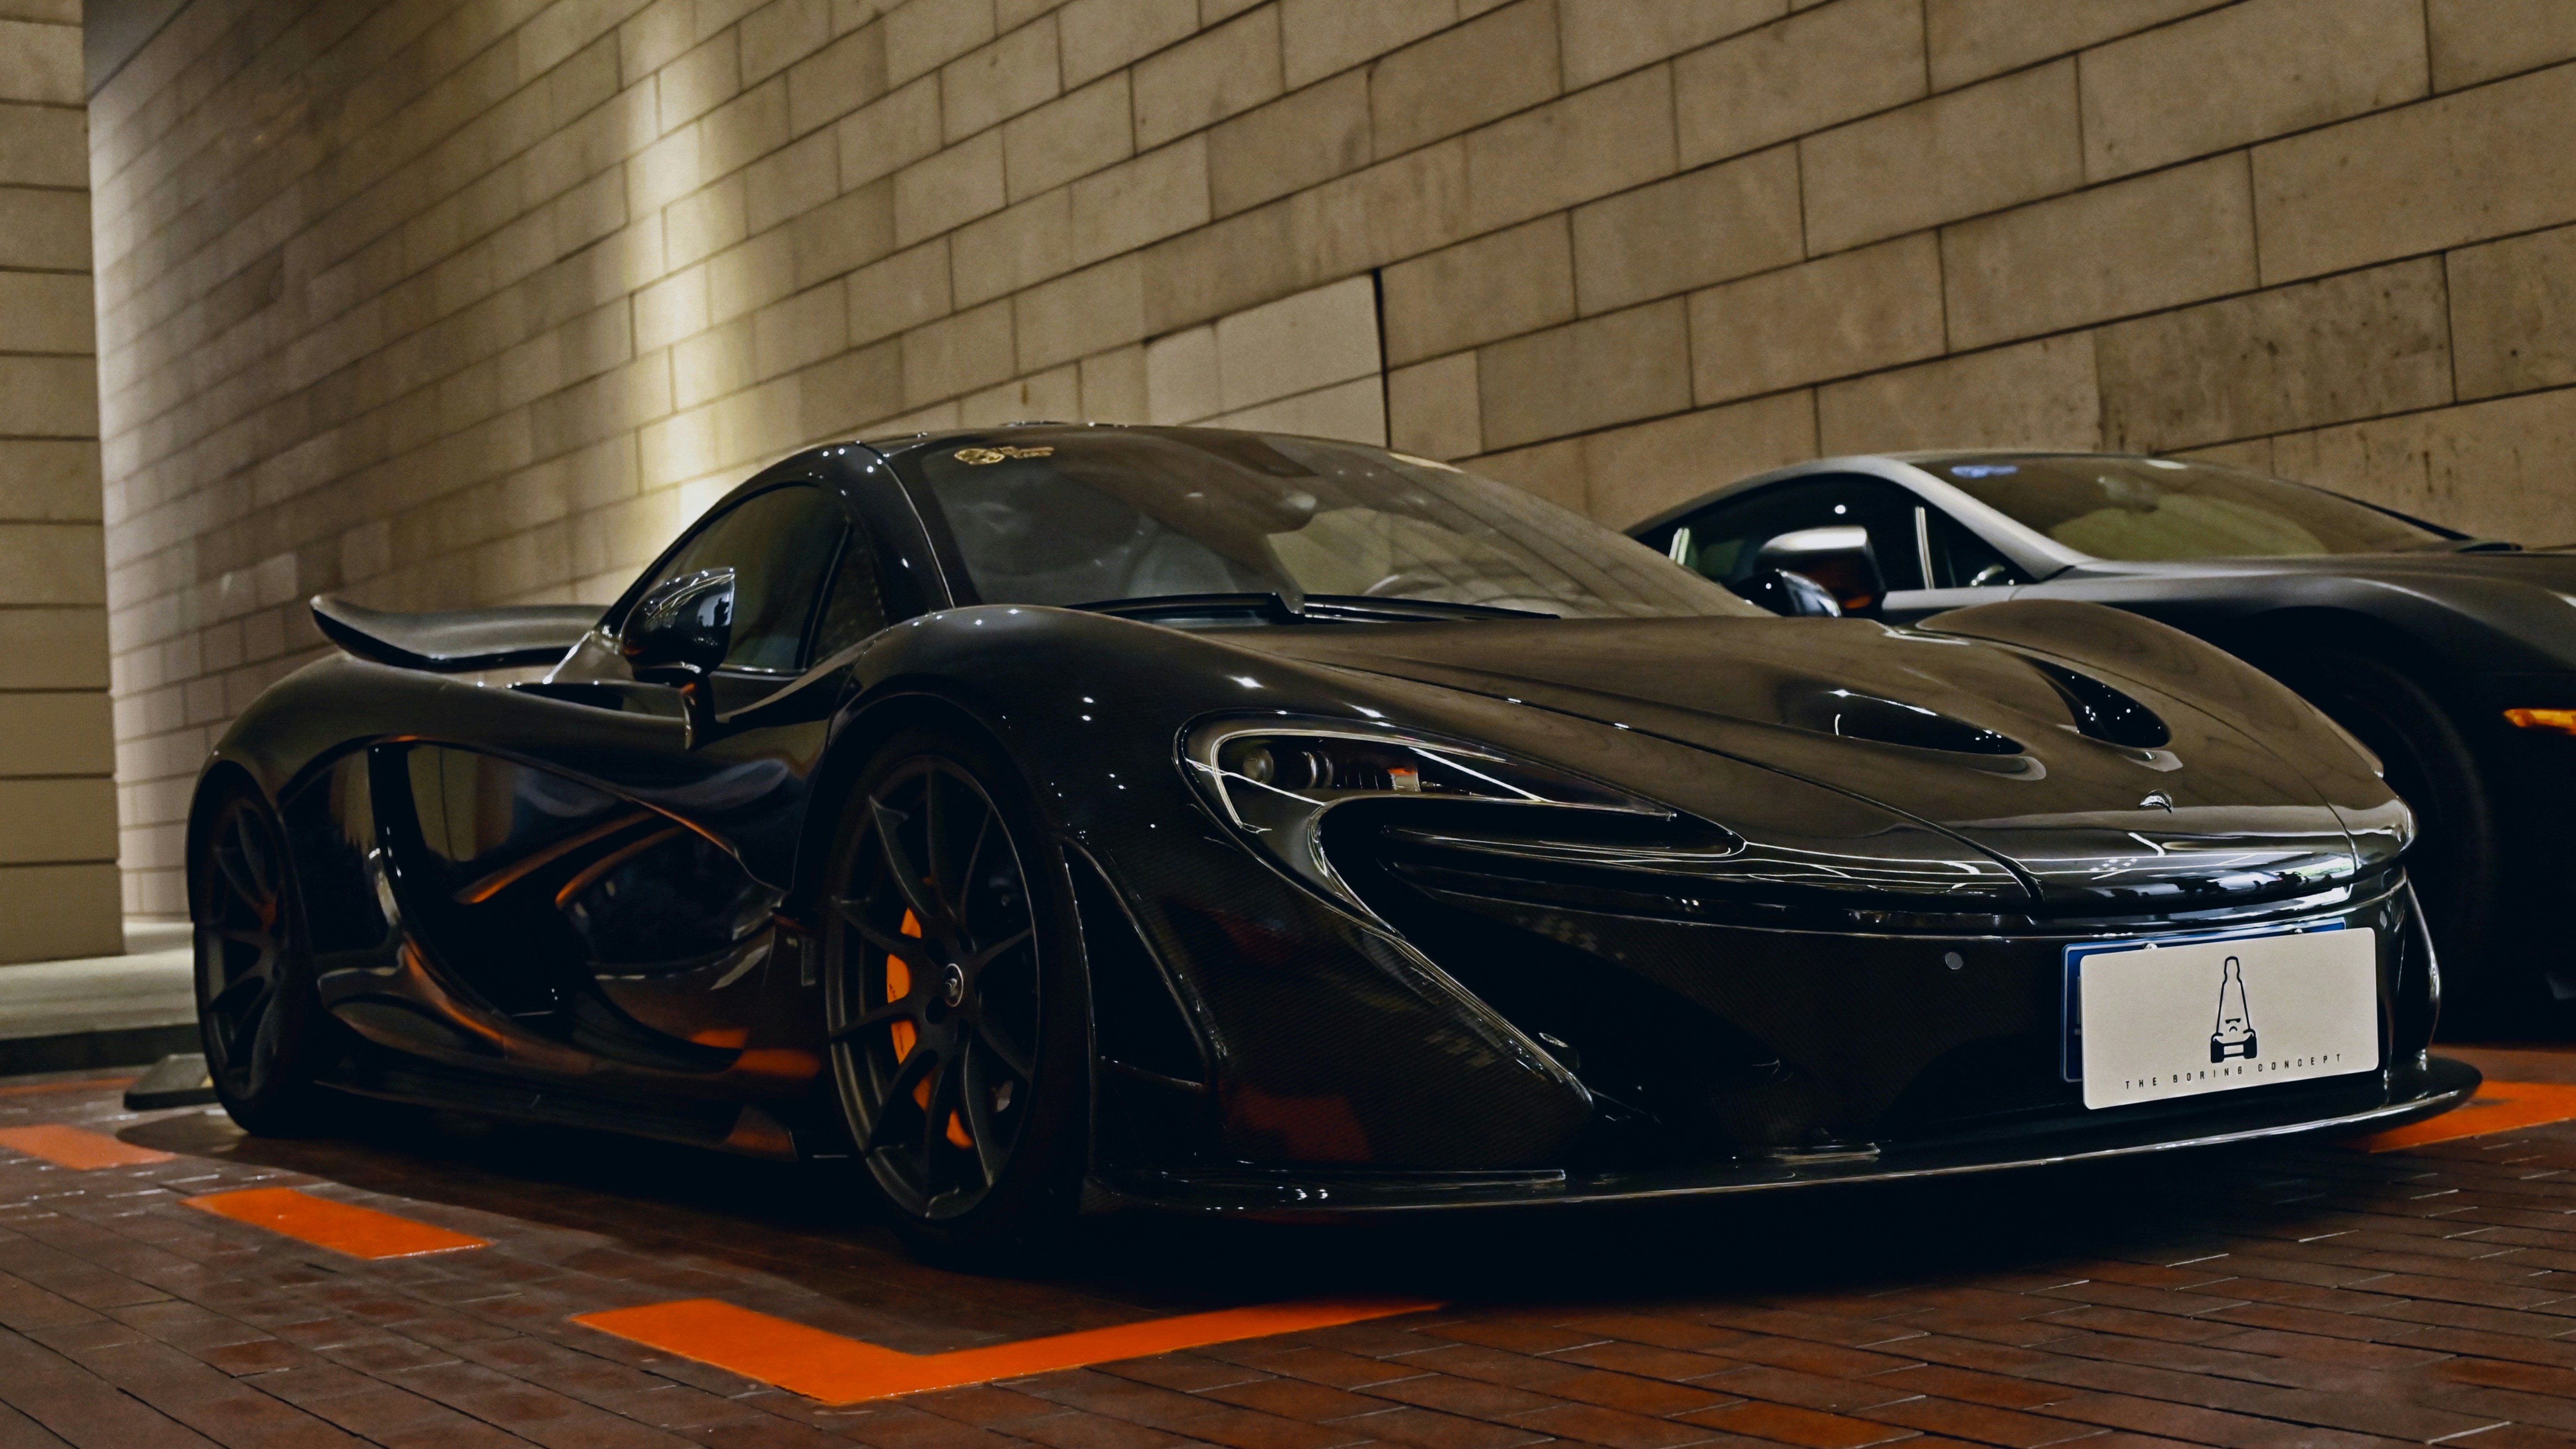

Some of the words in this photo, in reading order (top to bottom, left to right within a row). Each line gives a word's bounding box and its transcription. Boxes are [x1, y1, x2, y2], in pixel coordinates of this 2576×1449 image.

[2125, 1077, 2157, 1090] THE
[2173, 1065, 2243, 1084] BORING
[2257, 1053, 2341, 1073] CONCEPT
